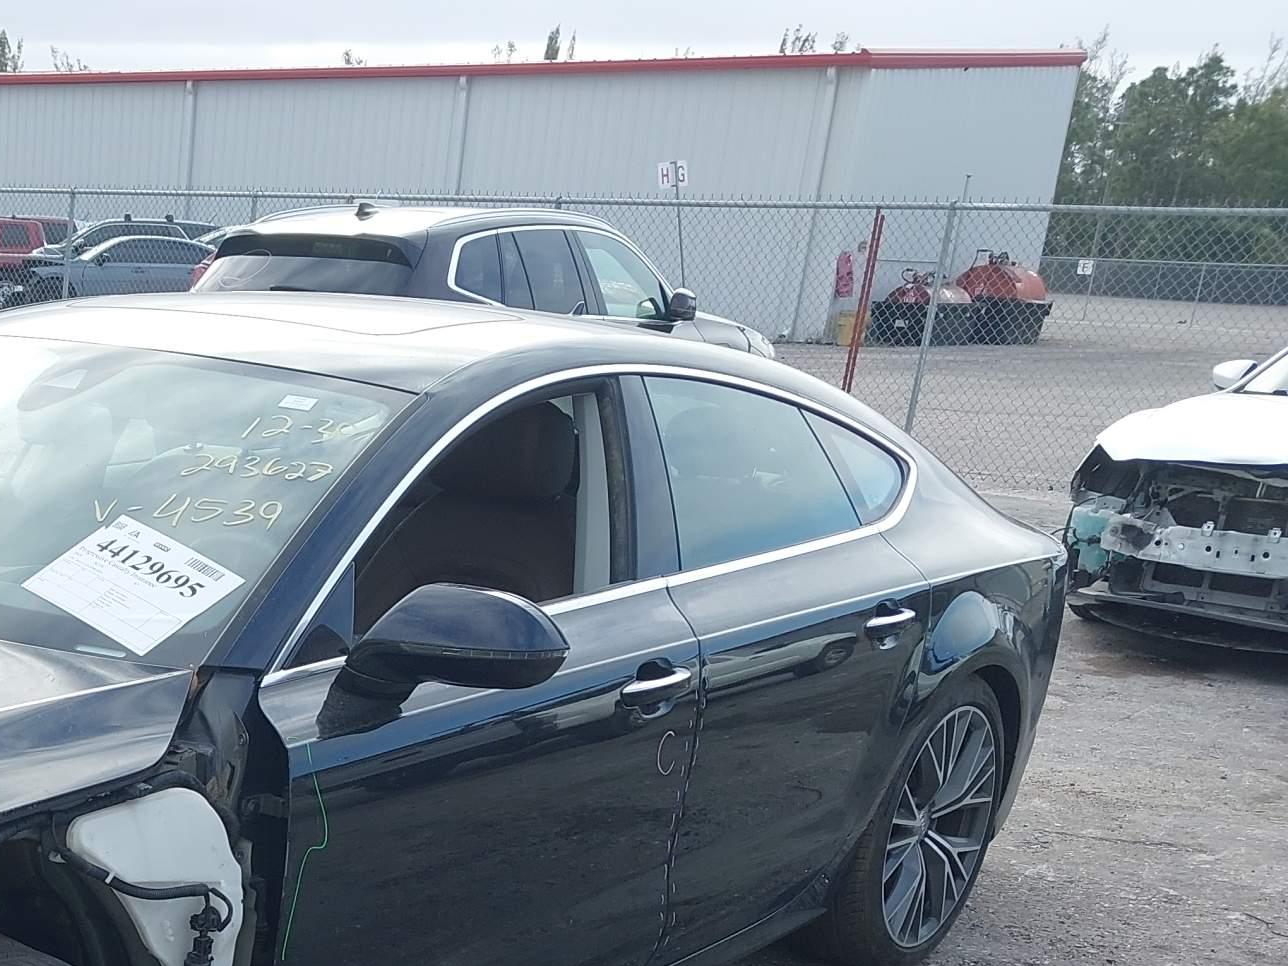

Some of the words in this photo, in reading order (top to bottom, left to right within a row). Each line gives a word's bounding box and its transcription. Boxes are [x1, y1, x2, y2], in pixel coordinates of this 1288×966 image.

[661, 167, 670, 185] H
[678, 165, 686, 183] G
[96, 538, 206, 599] 44129695
